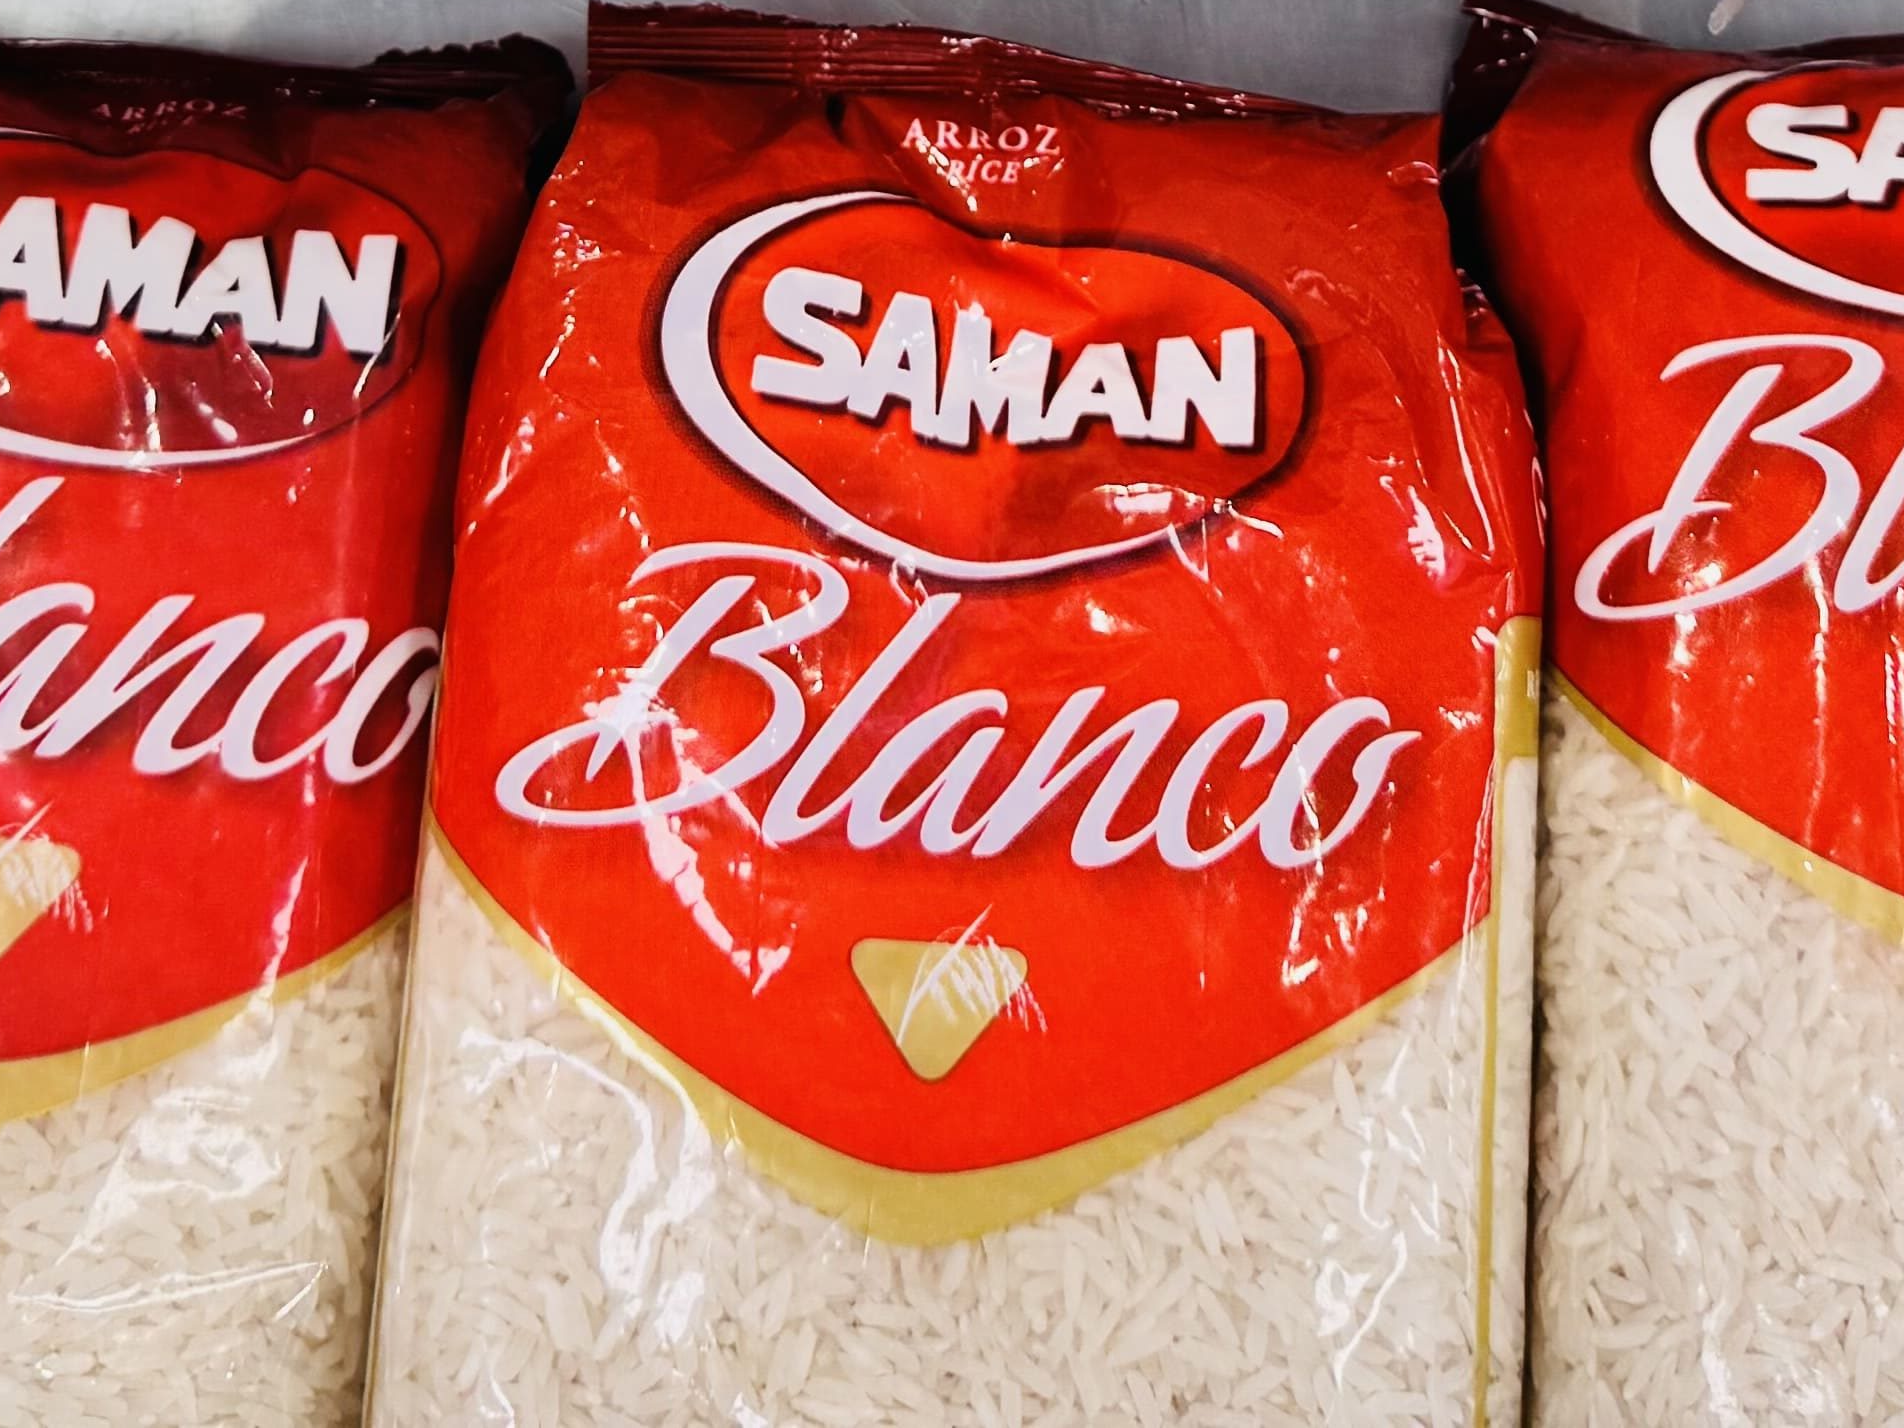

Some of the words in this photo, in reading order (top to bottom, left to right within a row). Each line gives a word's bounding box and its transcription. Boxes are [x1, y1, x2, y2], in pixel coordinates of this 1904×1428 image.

[901, 117, 1062, 156] ARROZ
[945, 154, 1023, 186] RICE
[749, 267, 1257, 449] SAMAN
[493, 540, 1423, 871] Blanco
